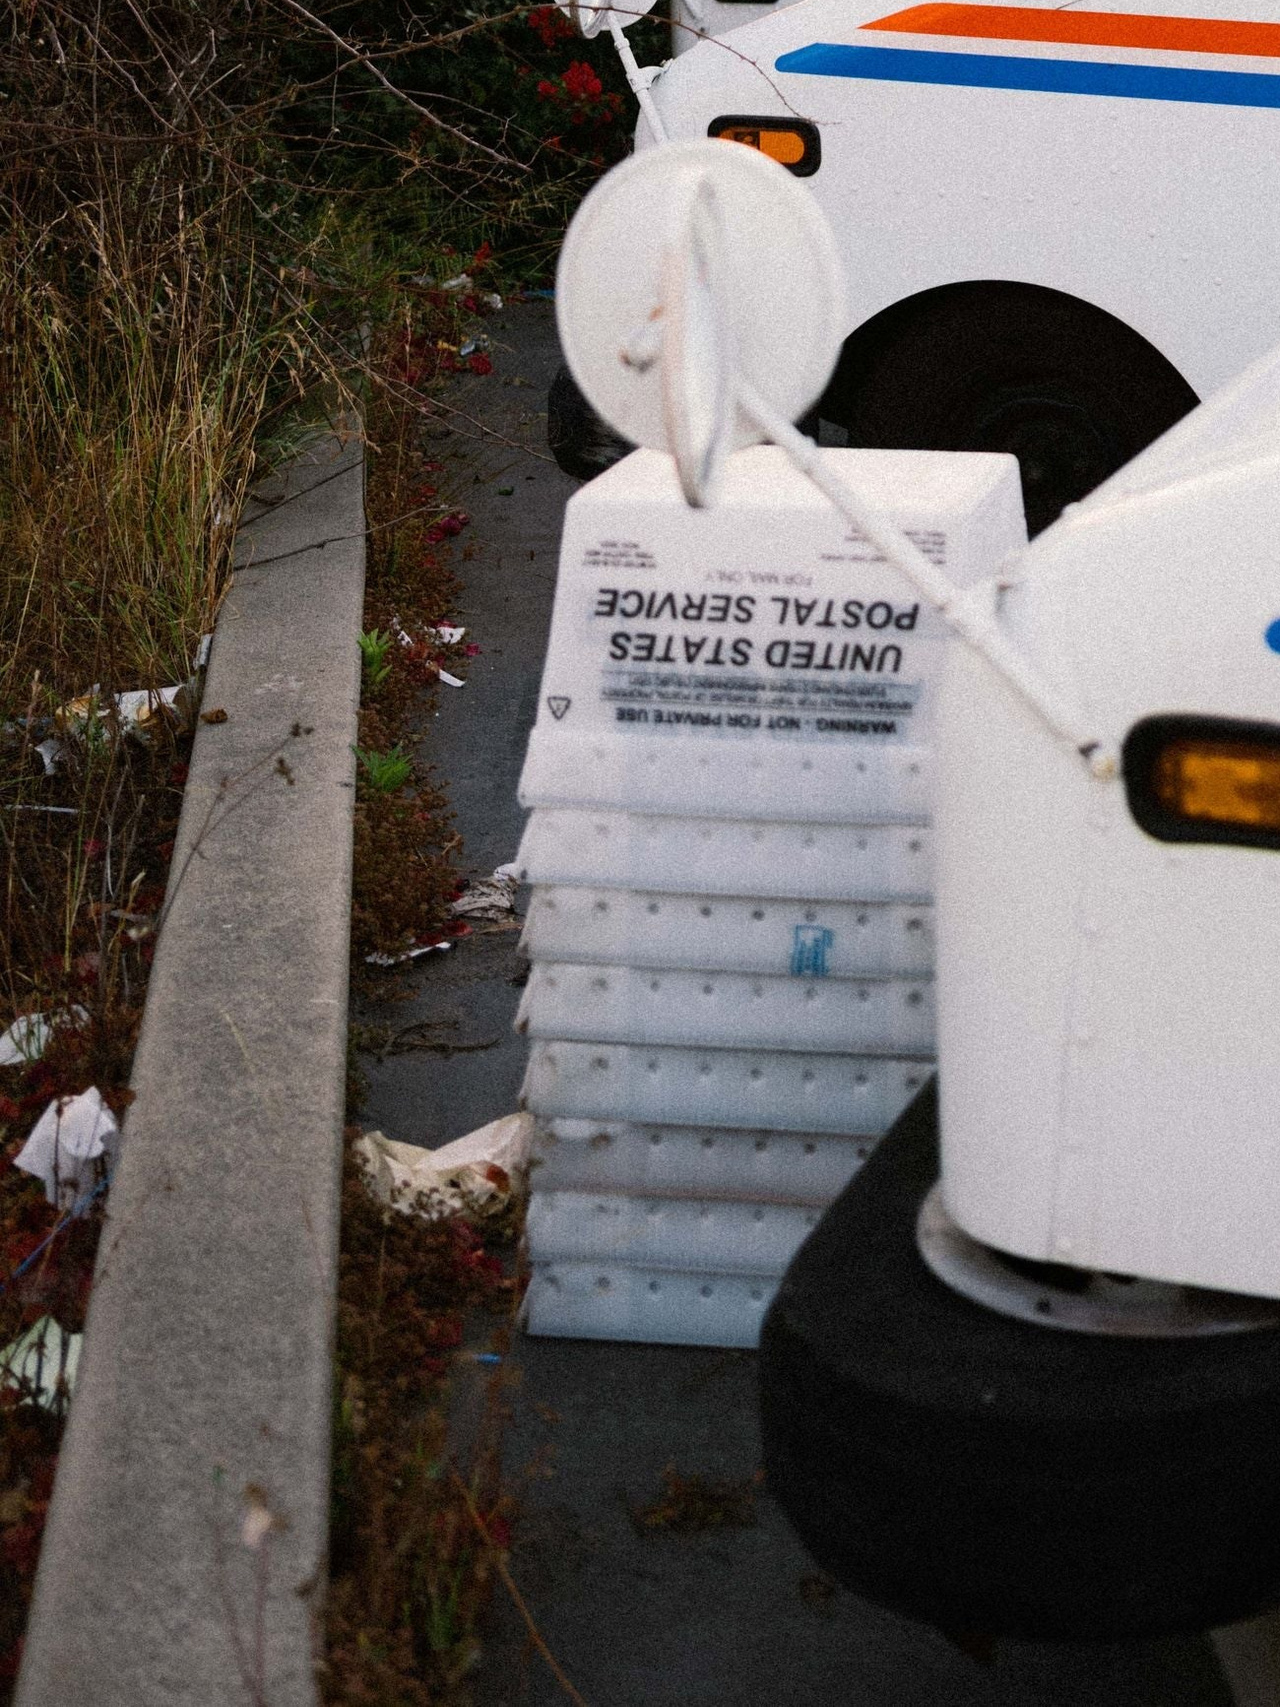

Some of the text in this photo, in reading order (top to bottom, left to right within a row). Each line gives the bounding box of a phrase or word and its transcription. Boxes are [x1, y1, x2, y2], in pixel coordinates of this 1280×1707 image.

[594, 588, 919, 631] POSTAL SERVICE
[609, 631, 903, 673] UNITED STATES
[615, 706, 649, 723] USE
[652, 708, 722, 726] PRIVATE
[726, 712, 761, 729] FOR
[767, 715, 800, 730] NOT
[815, 717, 897, 735] WARNING
